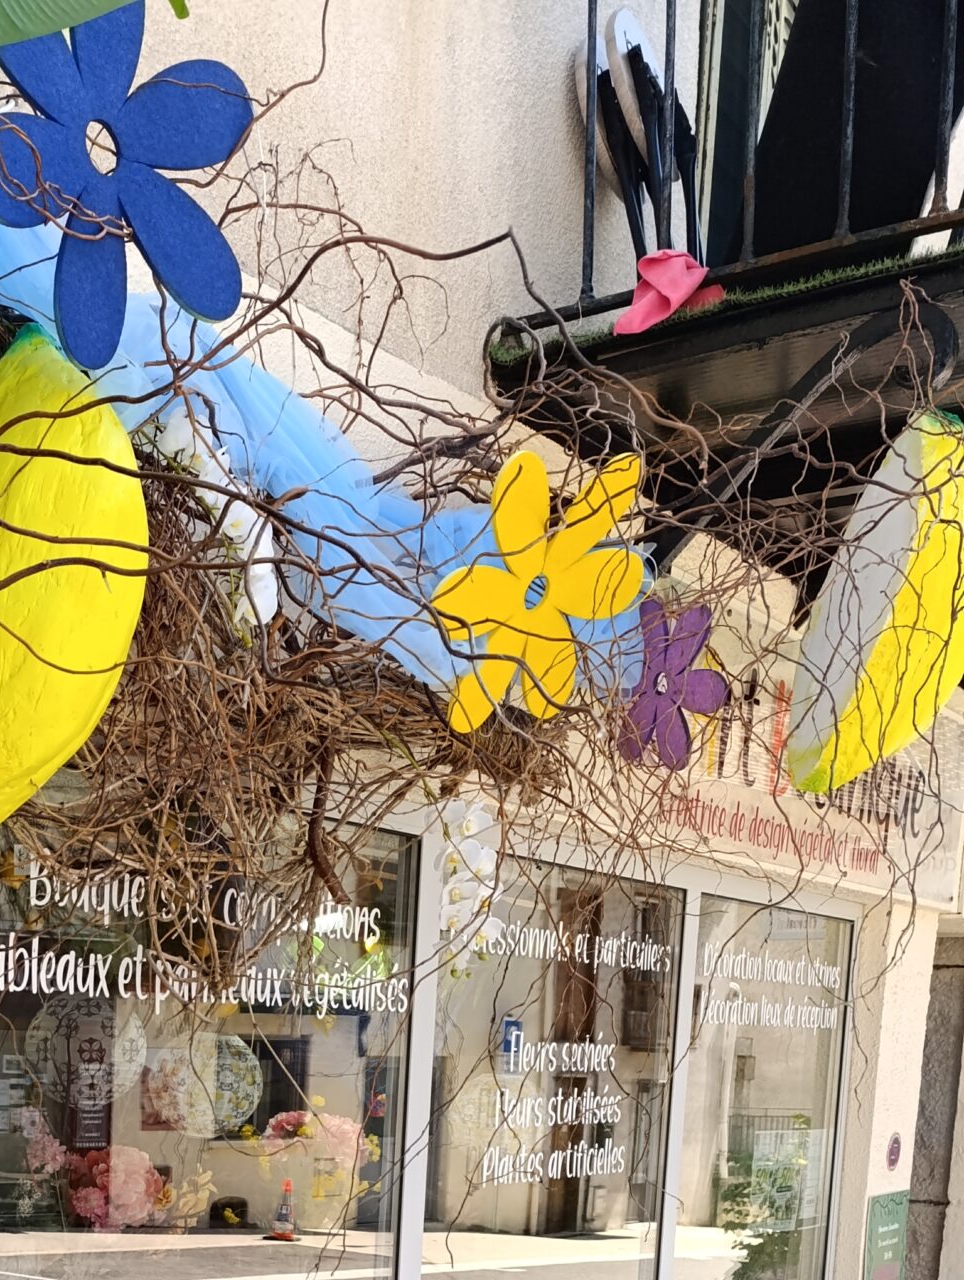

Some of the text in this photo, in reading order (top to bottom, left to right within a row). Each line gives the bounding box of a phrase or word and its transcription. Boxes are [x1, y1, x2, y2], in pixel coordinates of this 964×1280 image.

[729, 801, 745, 842] de
[749, 806, 792, 860] design
[793, 818, 836, 867] végétal
[837, 833, 849, 868] et
[851, 836, 881, 875] floral
[118, 944, 148, 1000] et
[576, 924, 590, 964] et
[593, 932, 671, 974] particuliers
[703, 941, 841, 989] Décoration locaux et vitrines
[700, 989, 838, 1036] Décoration lieux de réception
[510, 1031, 557, 1072] Fleurs
[495, 1084, 622, 1128] Fleurs stabilisées
[483, 1138, 626, 1188] Plantes artificielles
